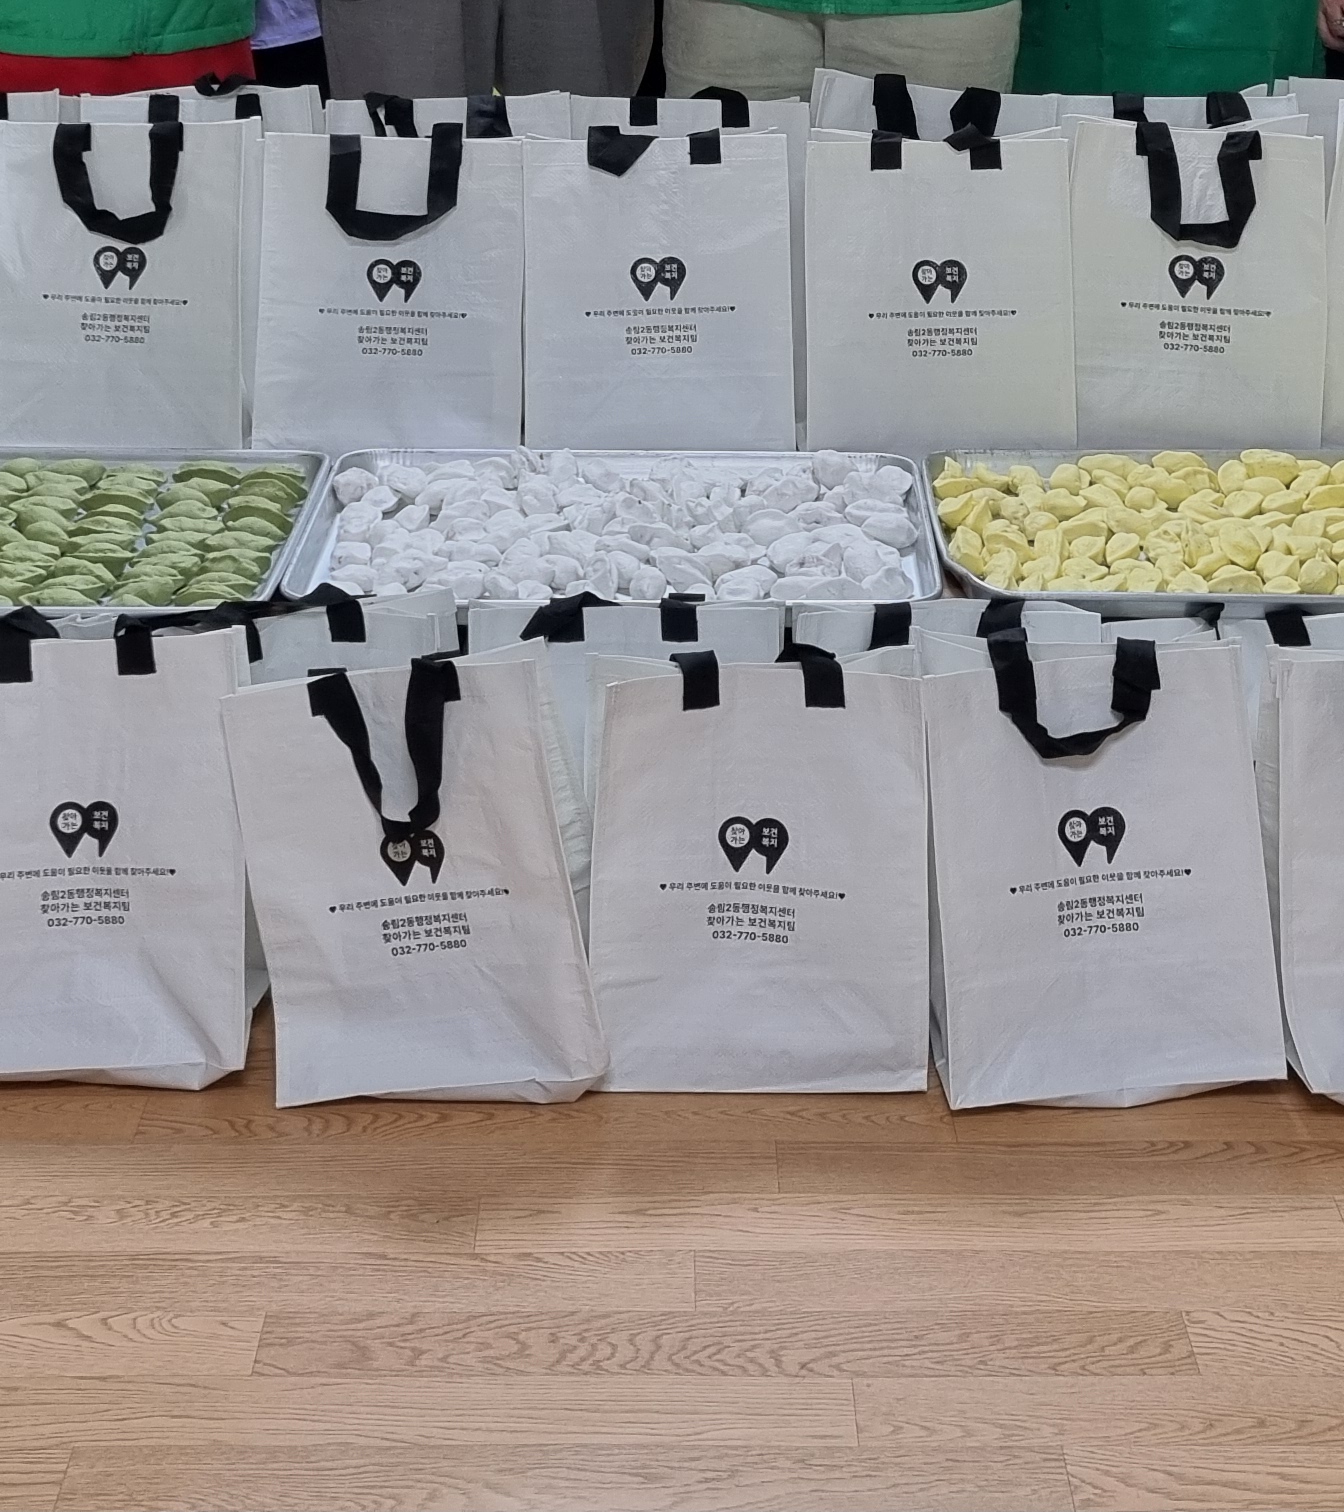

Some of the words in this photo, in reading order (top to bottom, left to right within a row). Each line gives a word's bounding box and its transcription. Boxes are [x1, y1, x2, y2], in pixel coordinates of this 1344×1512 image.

[47, 916, 125, 927] 032-770-5880
[712, 931, 788, 944] 032-770-5880
[1064, 923, 1139, 938] 032-770-5880
[391, 940, 467, 956] 032-770-5880
